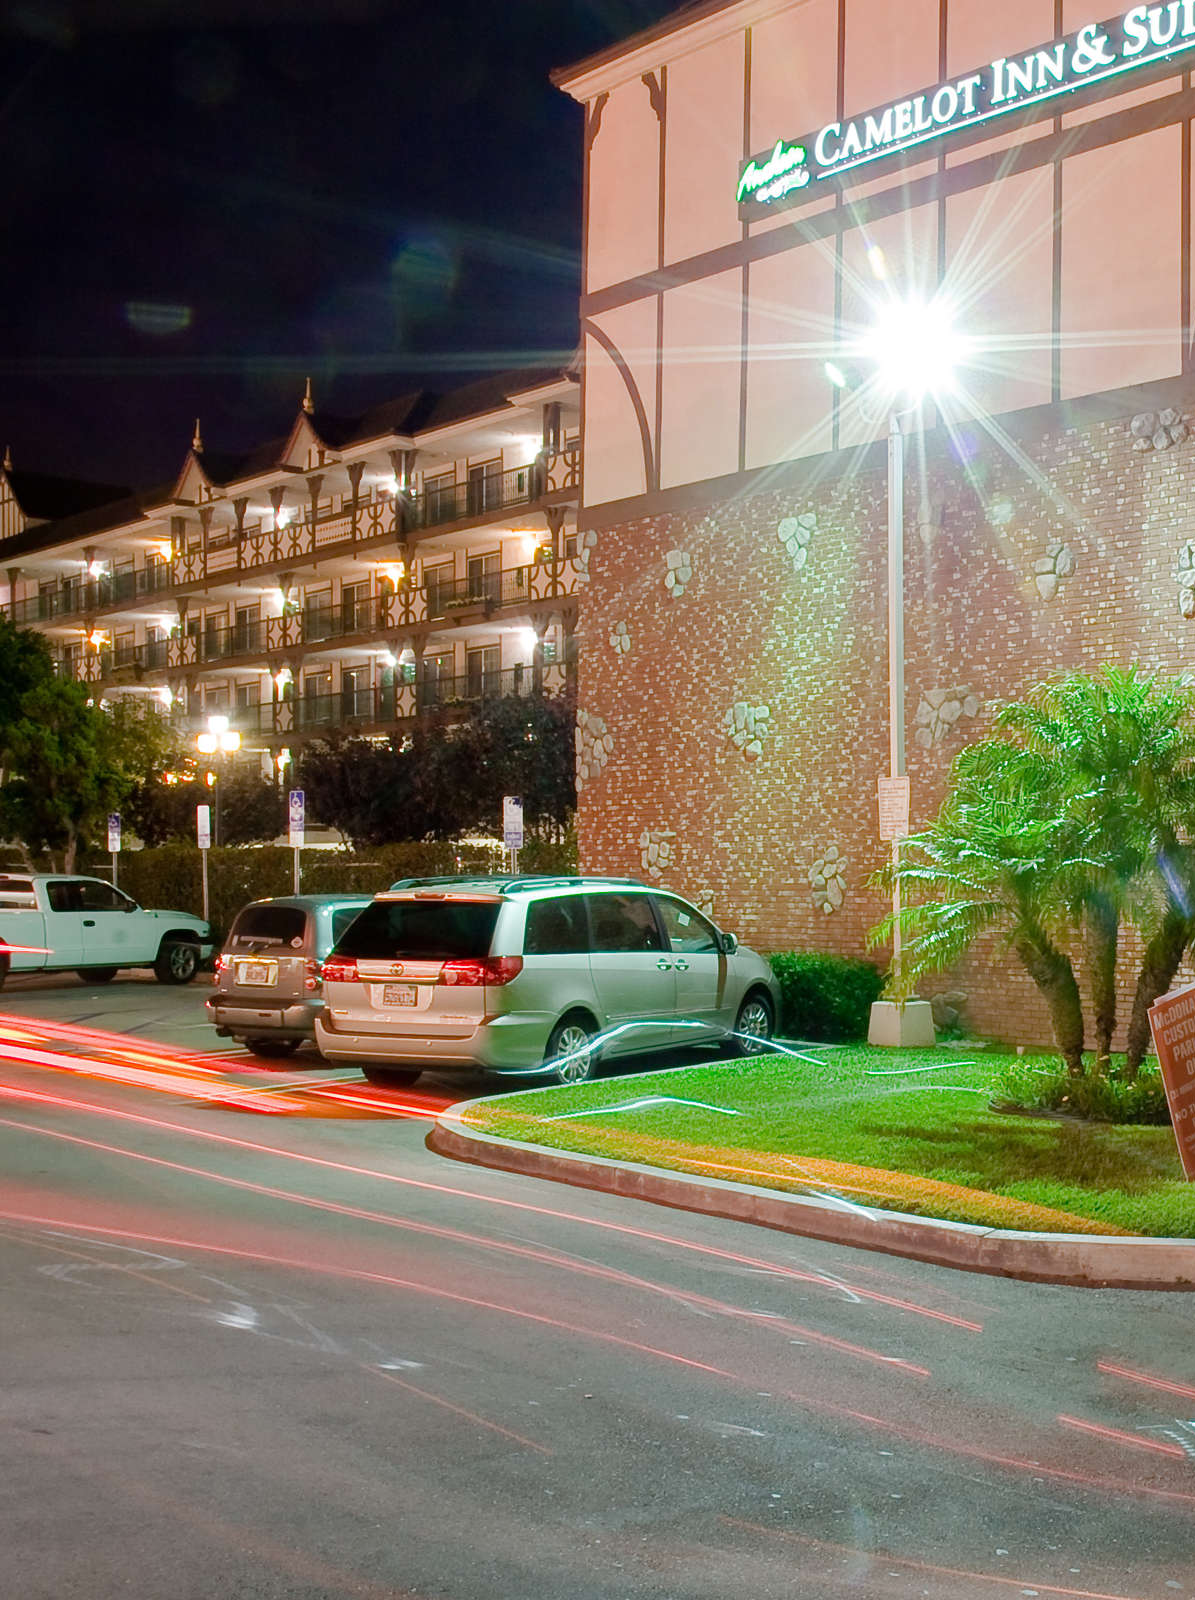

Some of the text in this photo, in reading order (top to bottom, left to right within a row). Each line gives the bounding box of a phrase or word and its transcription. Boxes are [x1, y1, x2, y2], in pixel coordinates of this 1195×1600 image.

[813, 74, 981, 167] CAMELOT
[990, 42, 1066, 105] INN
[1071, 23, 1117, 74] &
[1175, 1108, 1188, 1122] NO
